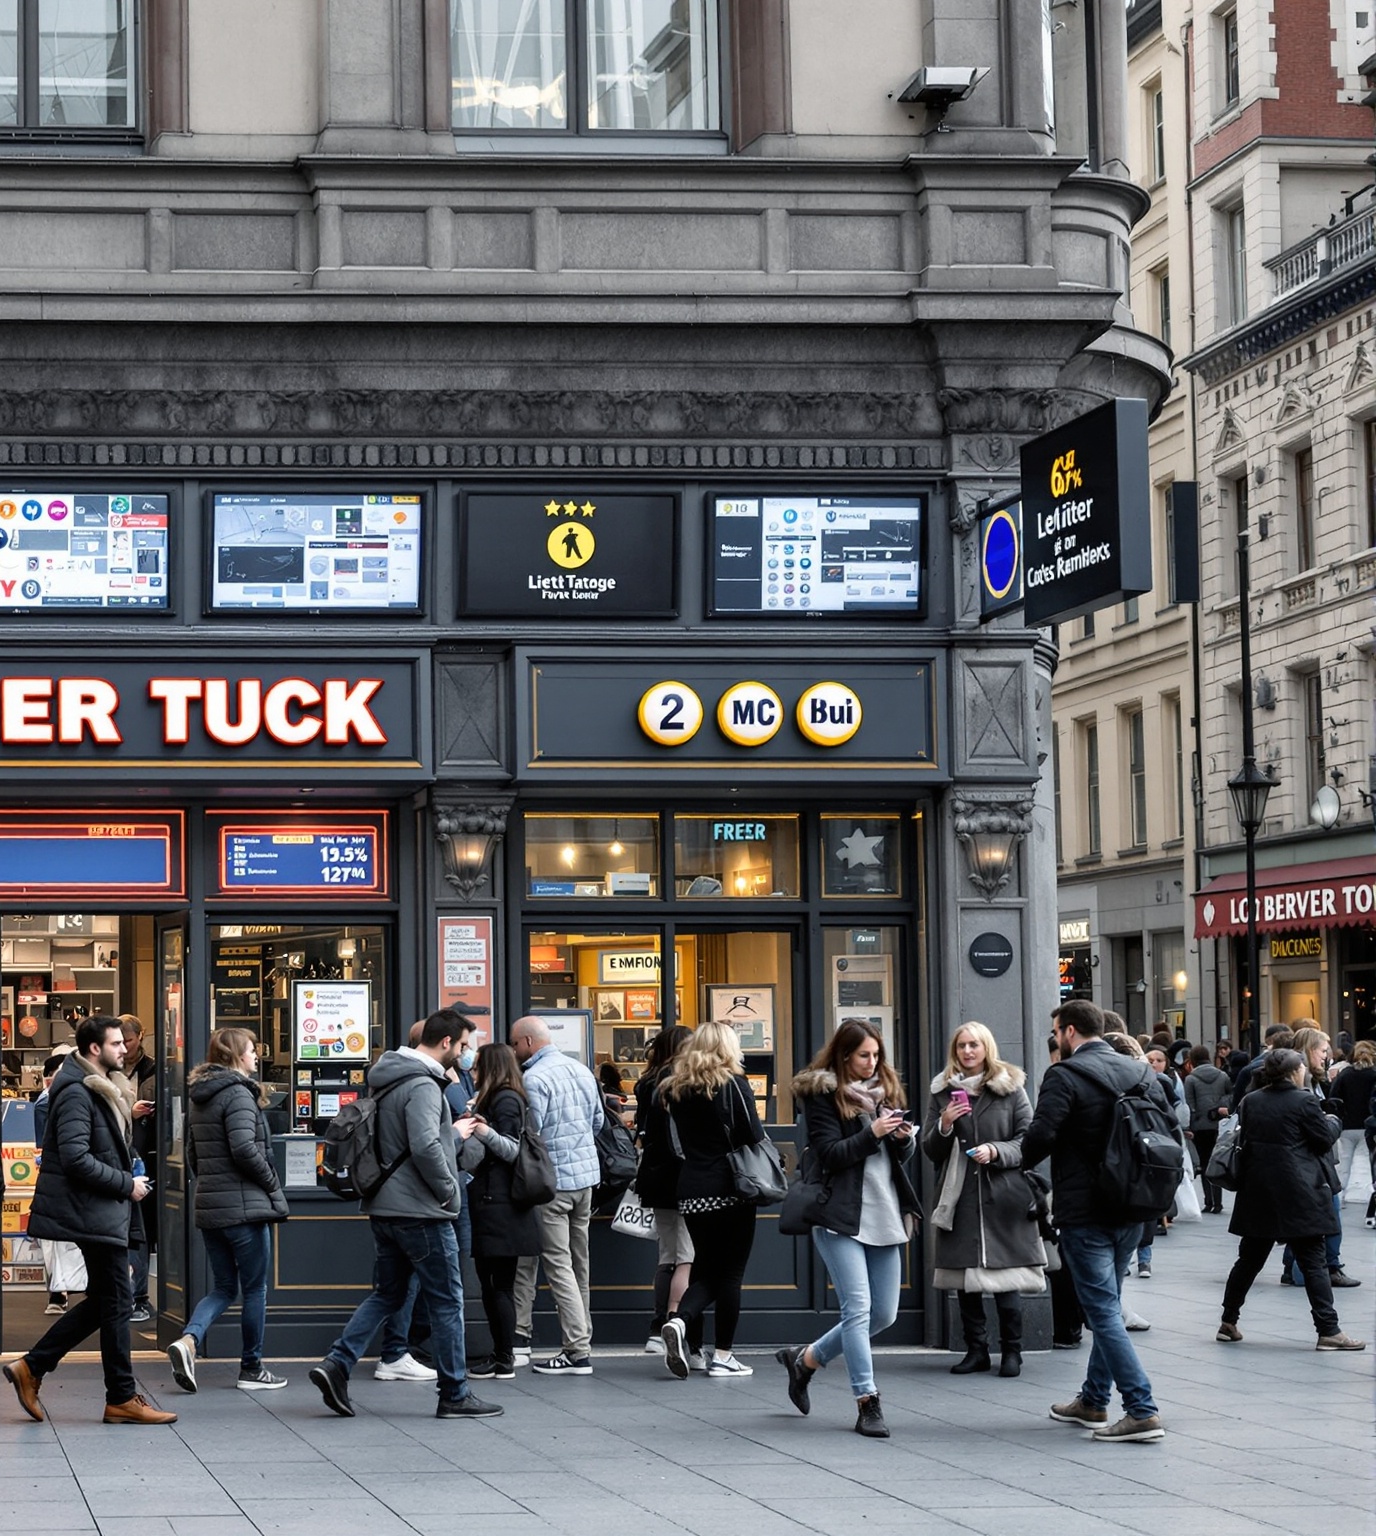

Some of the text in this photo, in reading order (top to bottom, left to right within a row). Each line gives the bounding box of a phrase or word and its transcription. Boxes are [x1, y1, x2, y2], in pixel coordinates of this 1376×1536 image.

[148, 676, 389, 746] TUCK
[659, 693, 685, 730] 2
[732, 698, 775, 726] MC
[810, 698, 853, 724] Bui
[1264, 888, 1337, 922] BERVER
